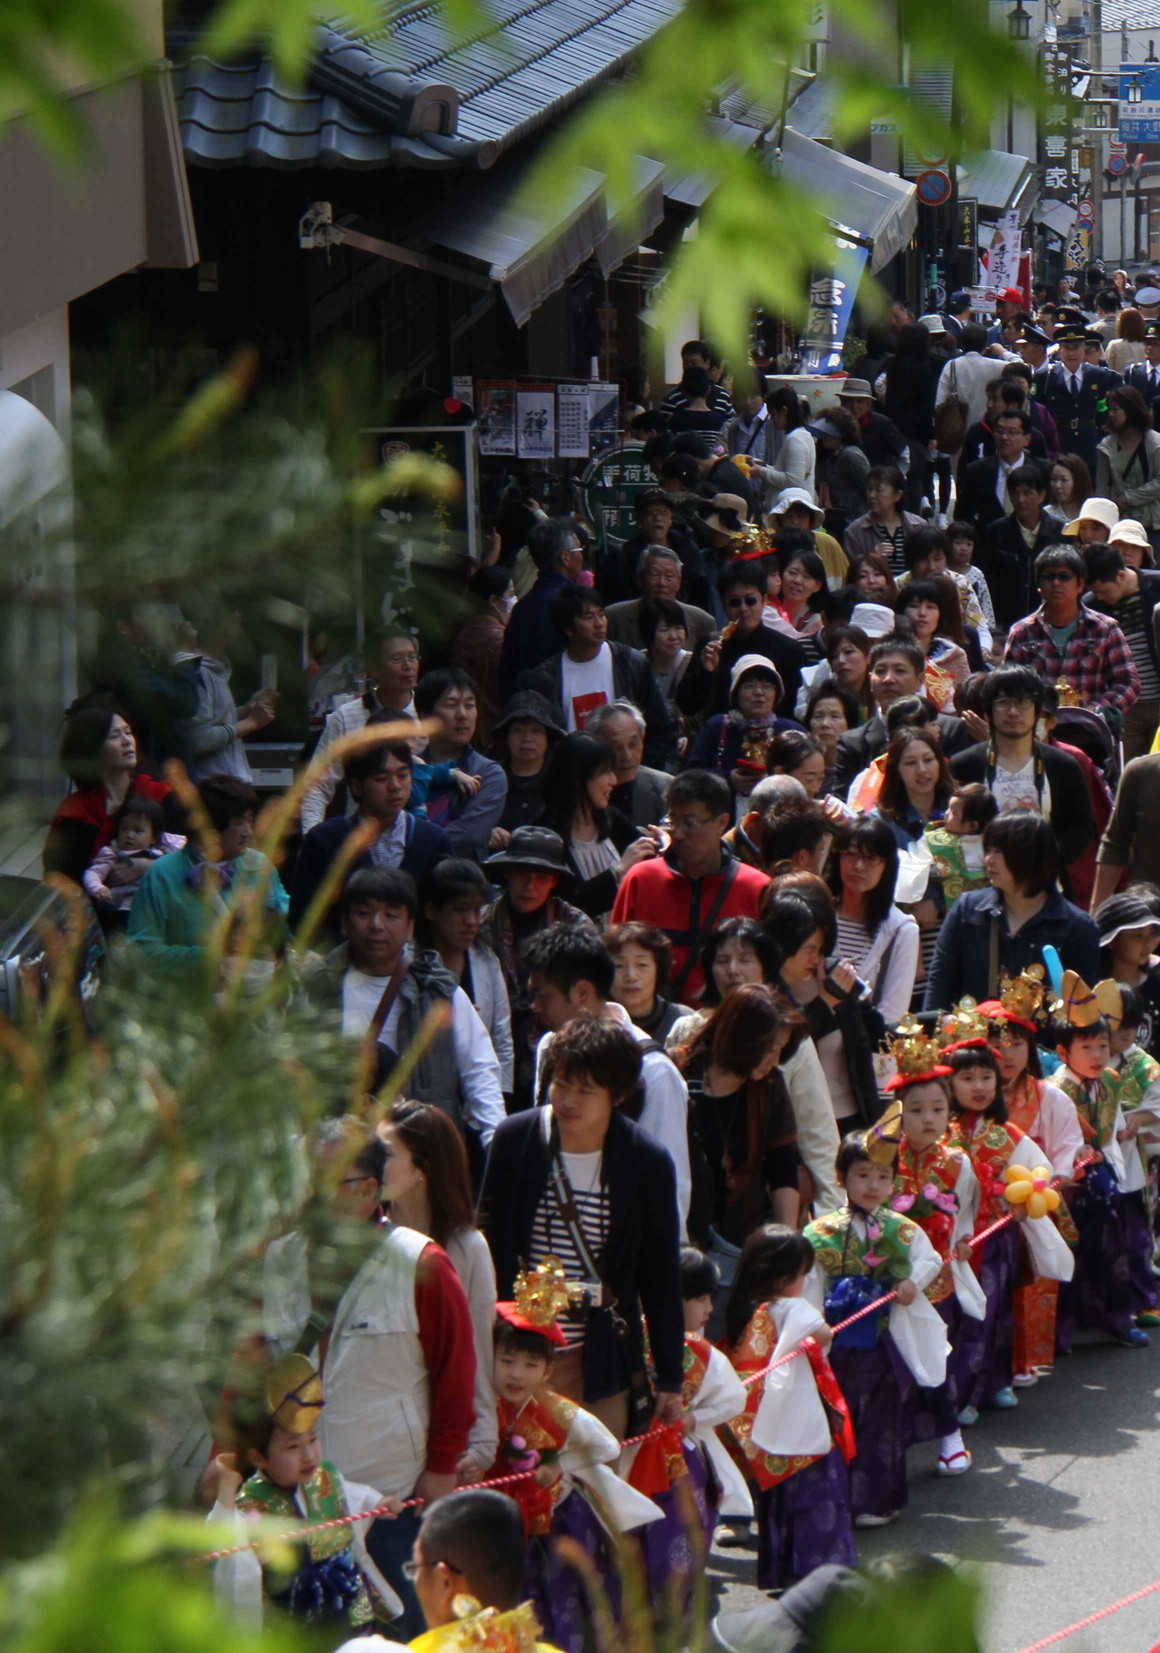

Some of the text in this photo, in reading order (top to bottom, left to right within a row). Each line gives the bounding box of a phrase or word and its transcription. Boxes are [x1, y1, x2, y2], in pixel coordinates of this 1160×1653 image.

[1121, 121, 1140, 132] 福井
[992, 243, 1009, 288] 手造り
